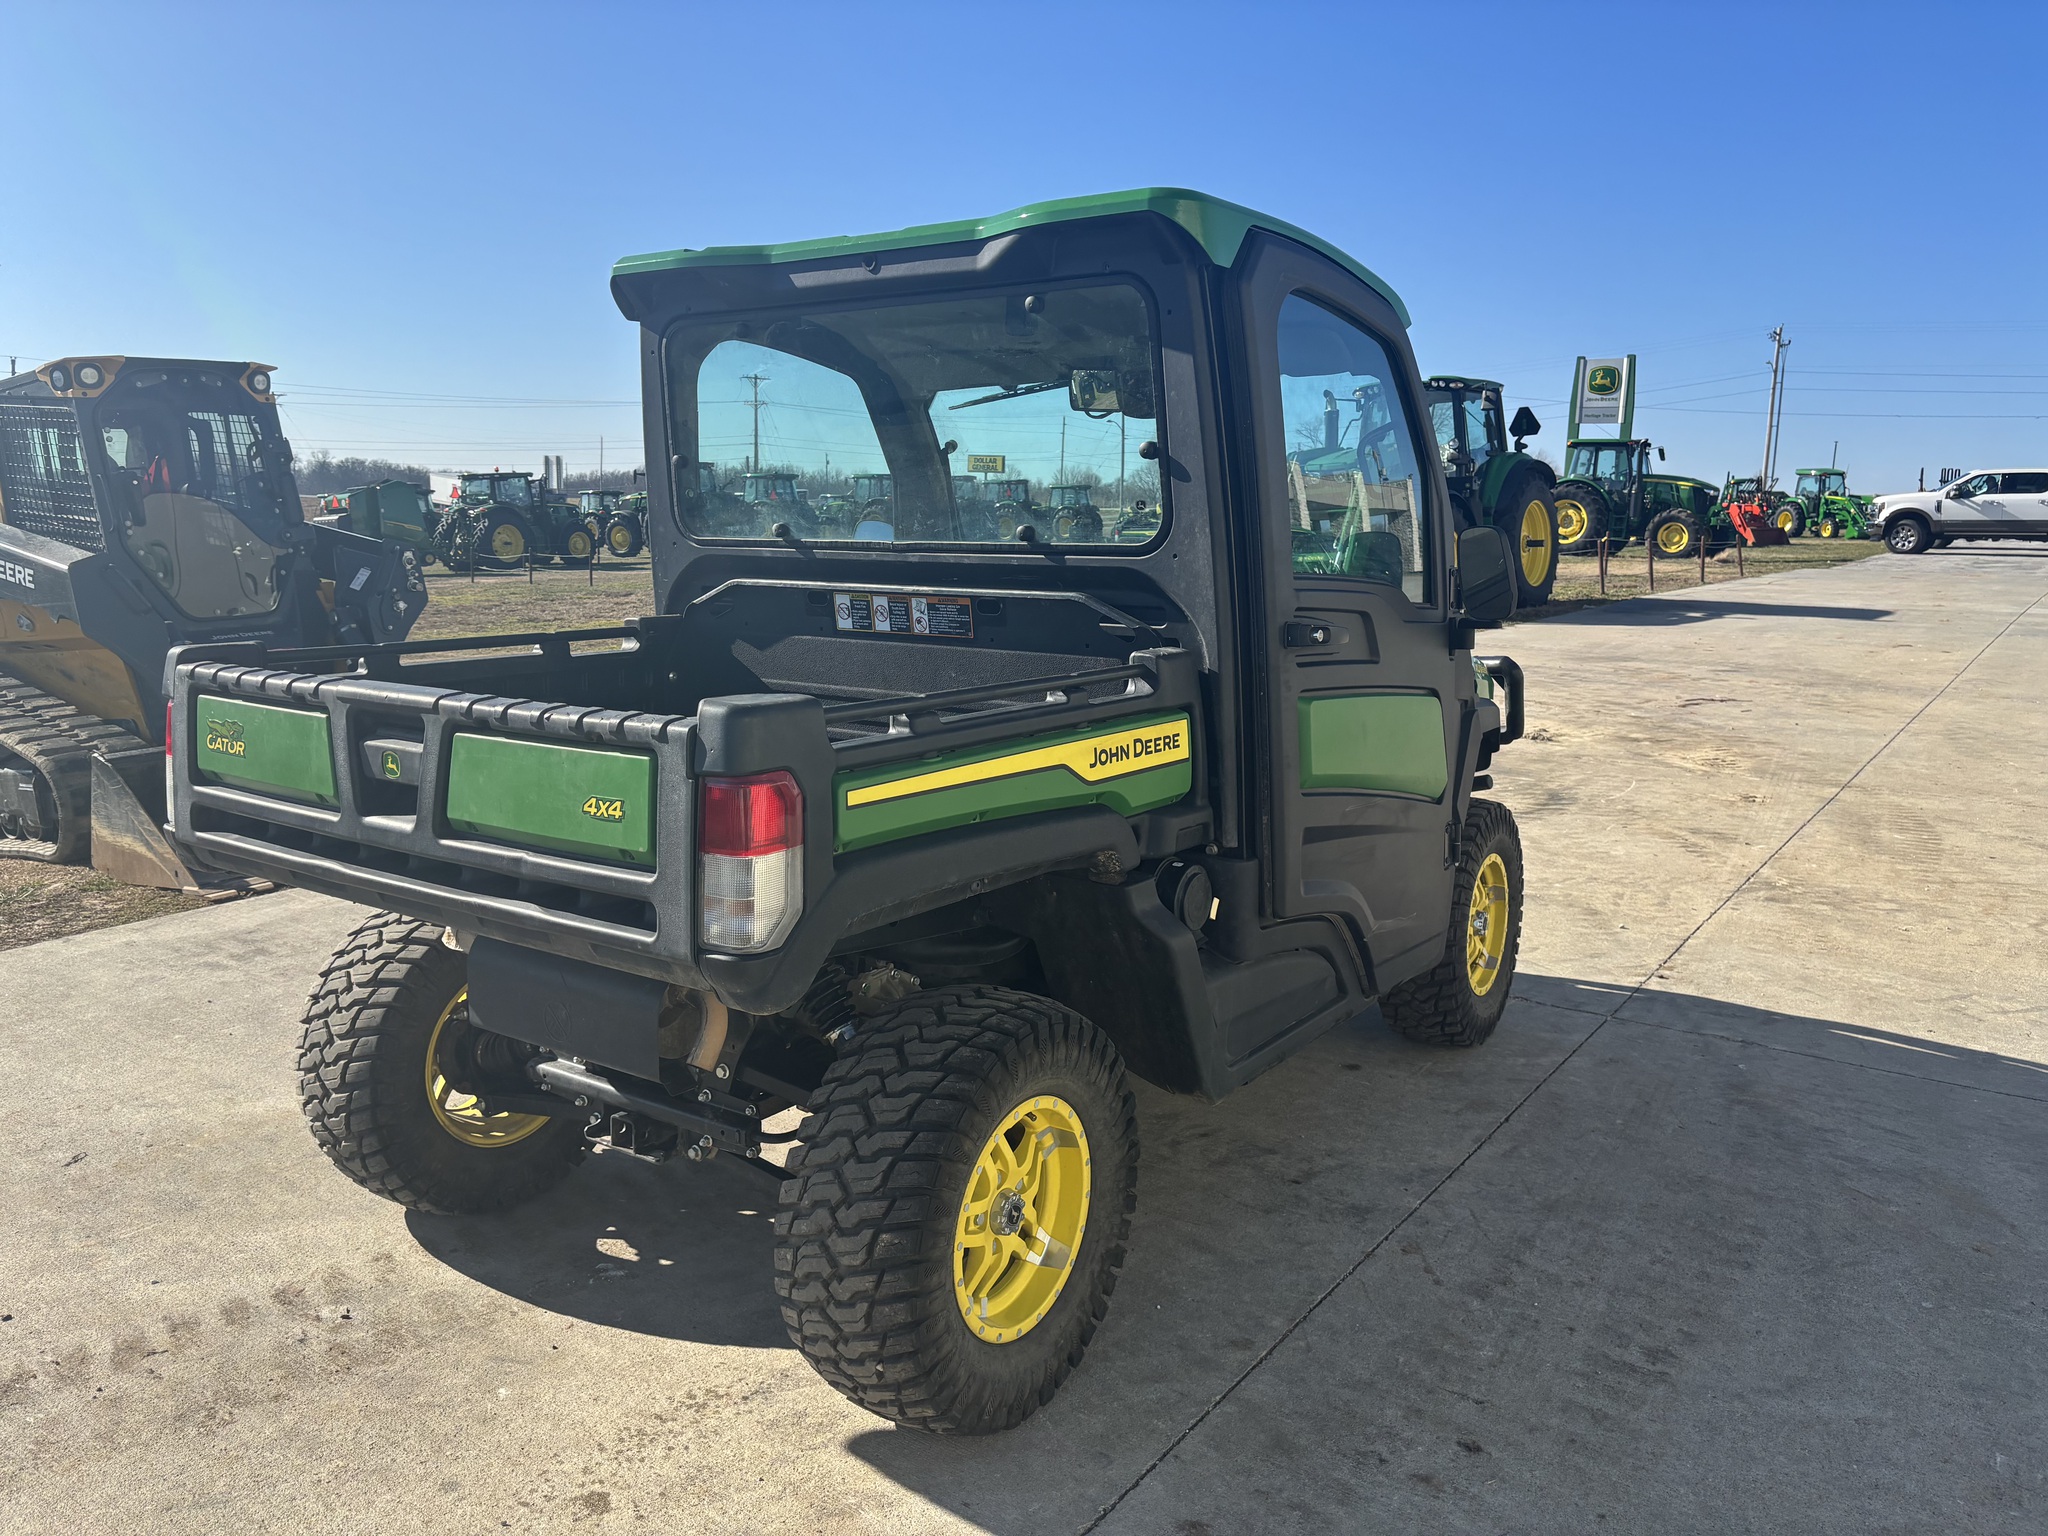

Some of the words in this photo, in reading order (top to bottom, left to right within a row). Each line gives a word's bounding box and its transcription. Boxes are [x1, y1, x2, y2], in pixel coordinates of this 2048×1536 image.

[206, 733, 246, 757] GATOR
[1089, 743, 1130, 769] JOHN
[1133, 733, 1180, 758] DEERE
